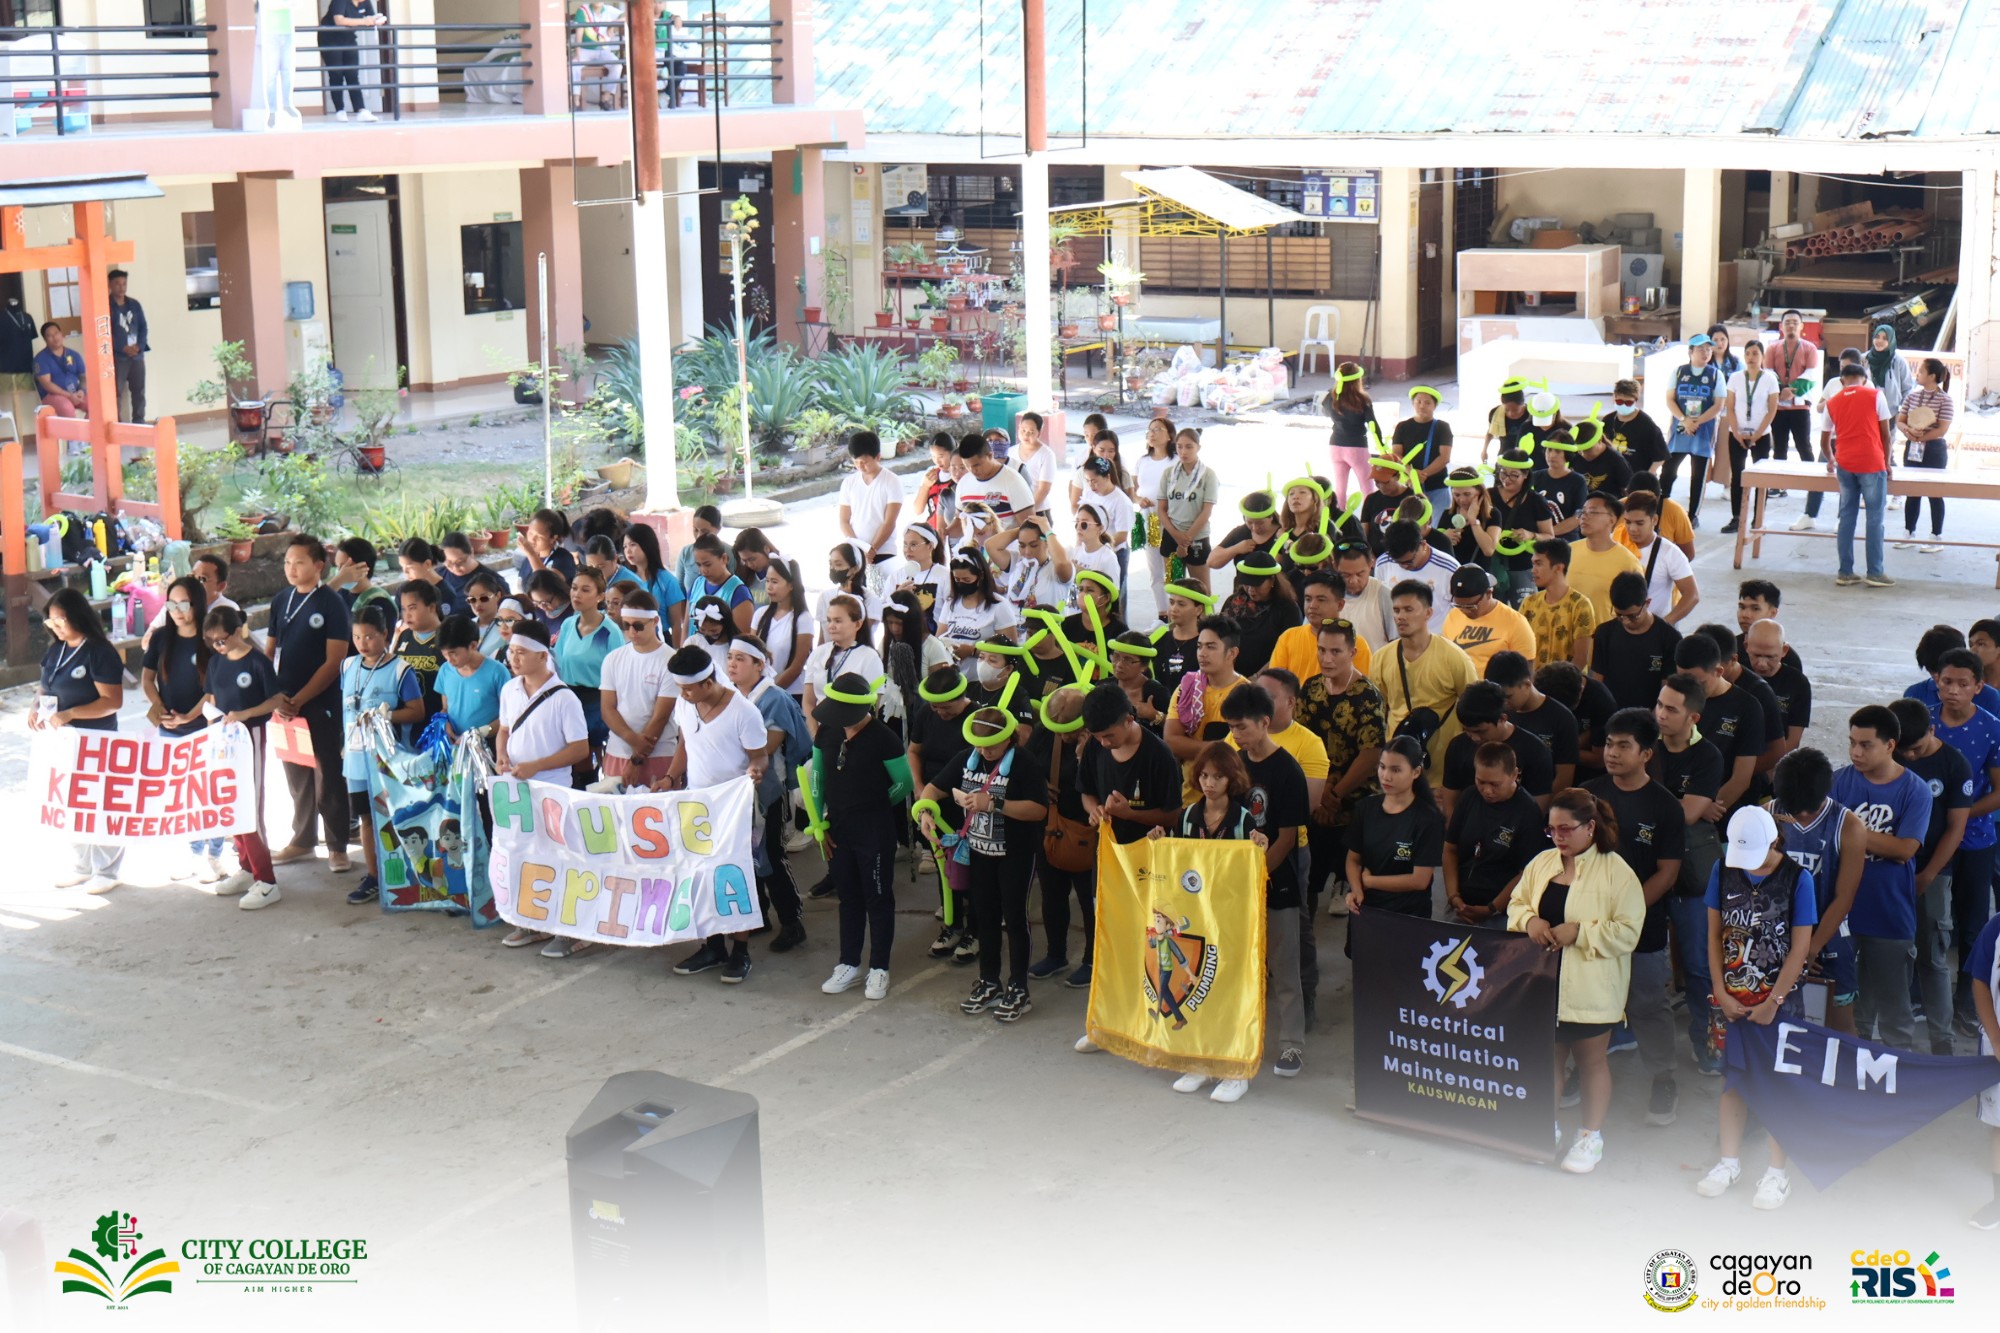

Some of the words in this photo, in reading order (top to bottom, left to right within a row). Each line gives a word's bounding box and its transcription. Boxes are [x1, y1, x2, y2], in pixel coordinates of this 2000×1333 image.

[1168, 489, 1197, 502] Jep
[1458, 625, 1494, 641] RUN
[76, 733, 209, 778] HOUSE
[47, 767, 238, 814] KEEPING
[962, 768, 1010, 787] KAAMLAN
[40, 804, 66, 829] NC
[106, 806, 235, 836] WEEKENDS
[491, 781, 714, 859] HOUSE
[1186, 944, 1218, 1012] PLUMBING
[1399, 1007, 1505, 1042] Electrical
[1389, 1030, 1520, 1072] Installation
[1774, 1021, 1899, 1094] EIM
[1383, 1055, 1527, 1099] Maintenance
[1407, 1081, 1498, 1111] KAUSWAGAN
